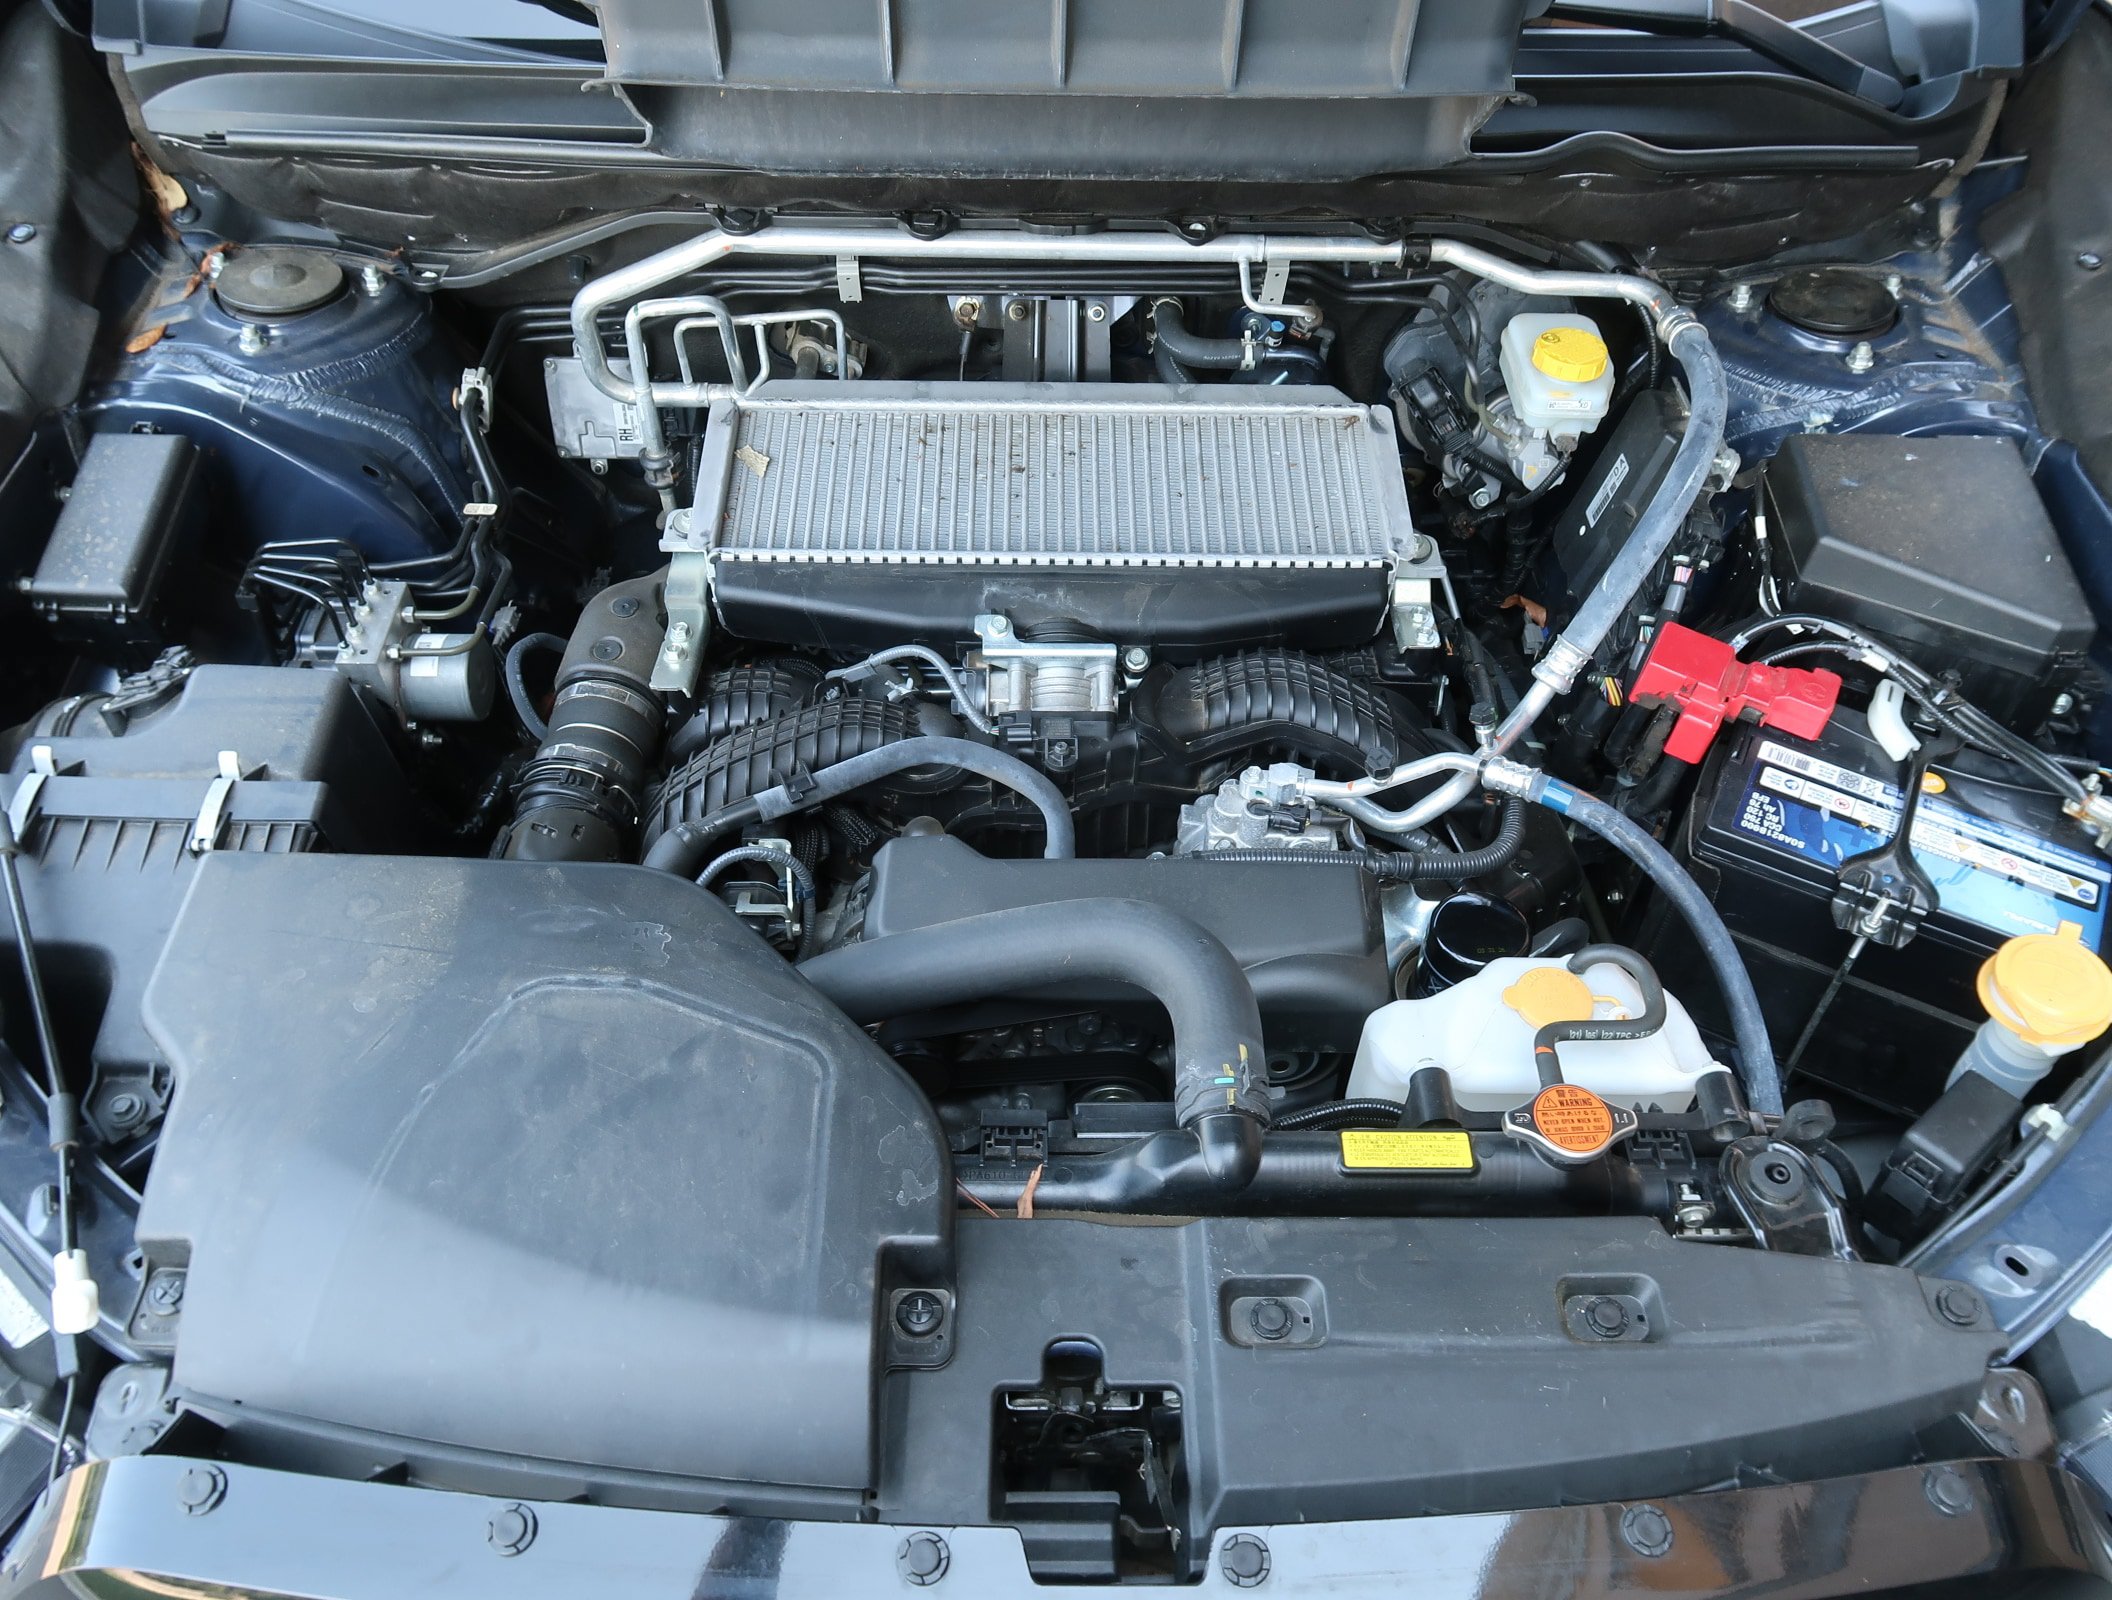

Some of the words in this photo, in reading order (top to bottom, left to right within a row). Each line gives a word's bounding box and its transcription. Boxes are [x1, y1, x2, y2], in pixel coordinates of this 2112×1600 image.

[618, 428, 634, 442] RH
[1751, 791, 1771, 803] EFB
[1745, 805, 1764, 817] 120
[1762, 801, 1778, 812] Ah
[1742, 812, 1763, 825] 750
[1764, 812, 1781, 824] RC
[1762, 820, 1784, 833] CCA
[1615, 1031, 1632, 1040] TPC
[1558, 1097, 1594, 1108] WARNING
[1576, 1117, 1592, 1125] WHEN
